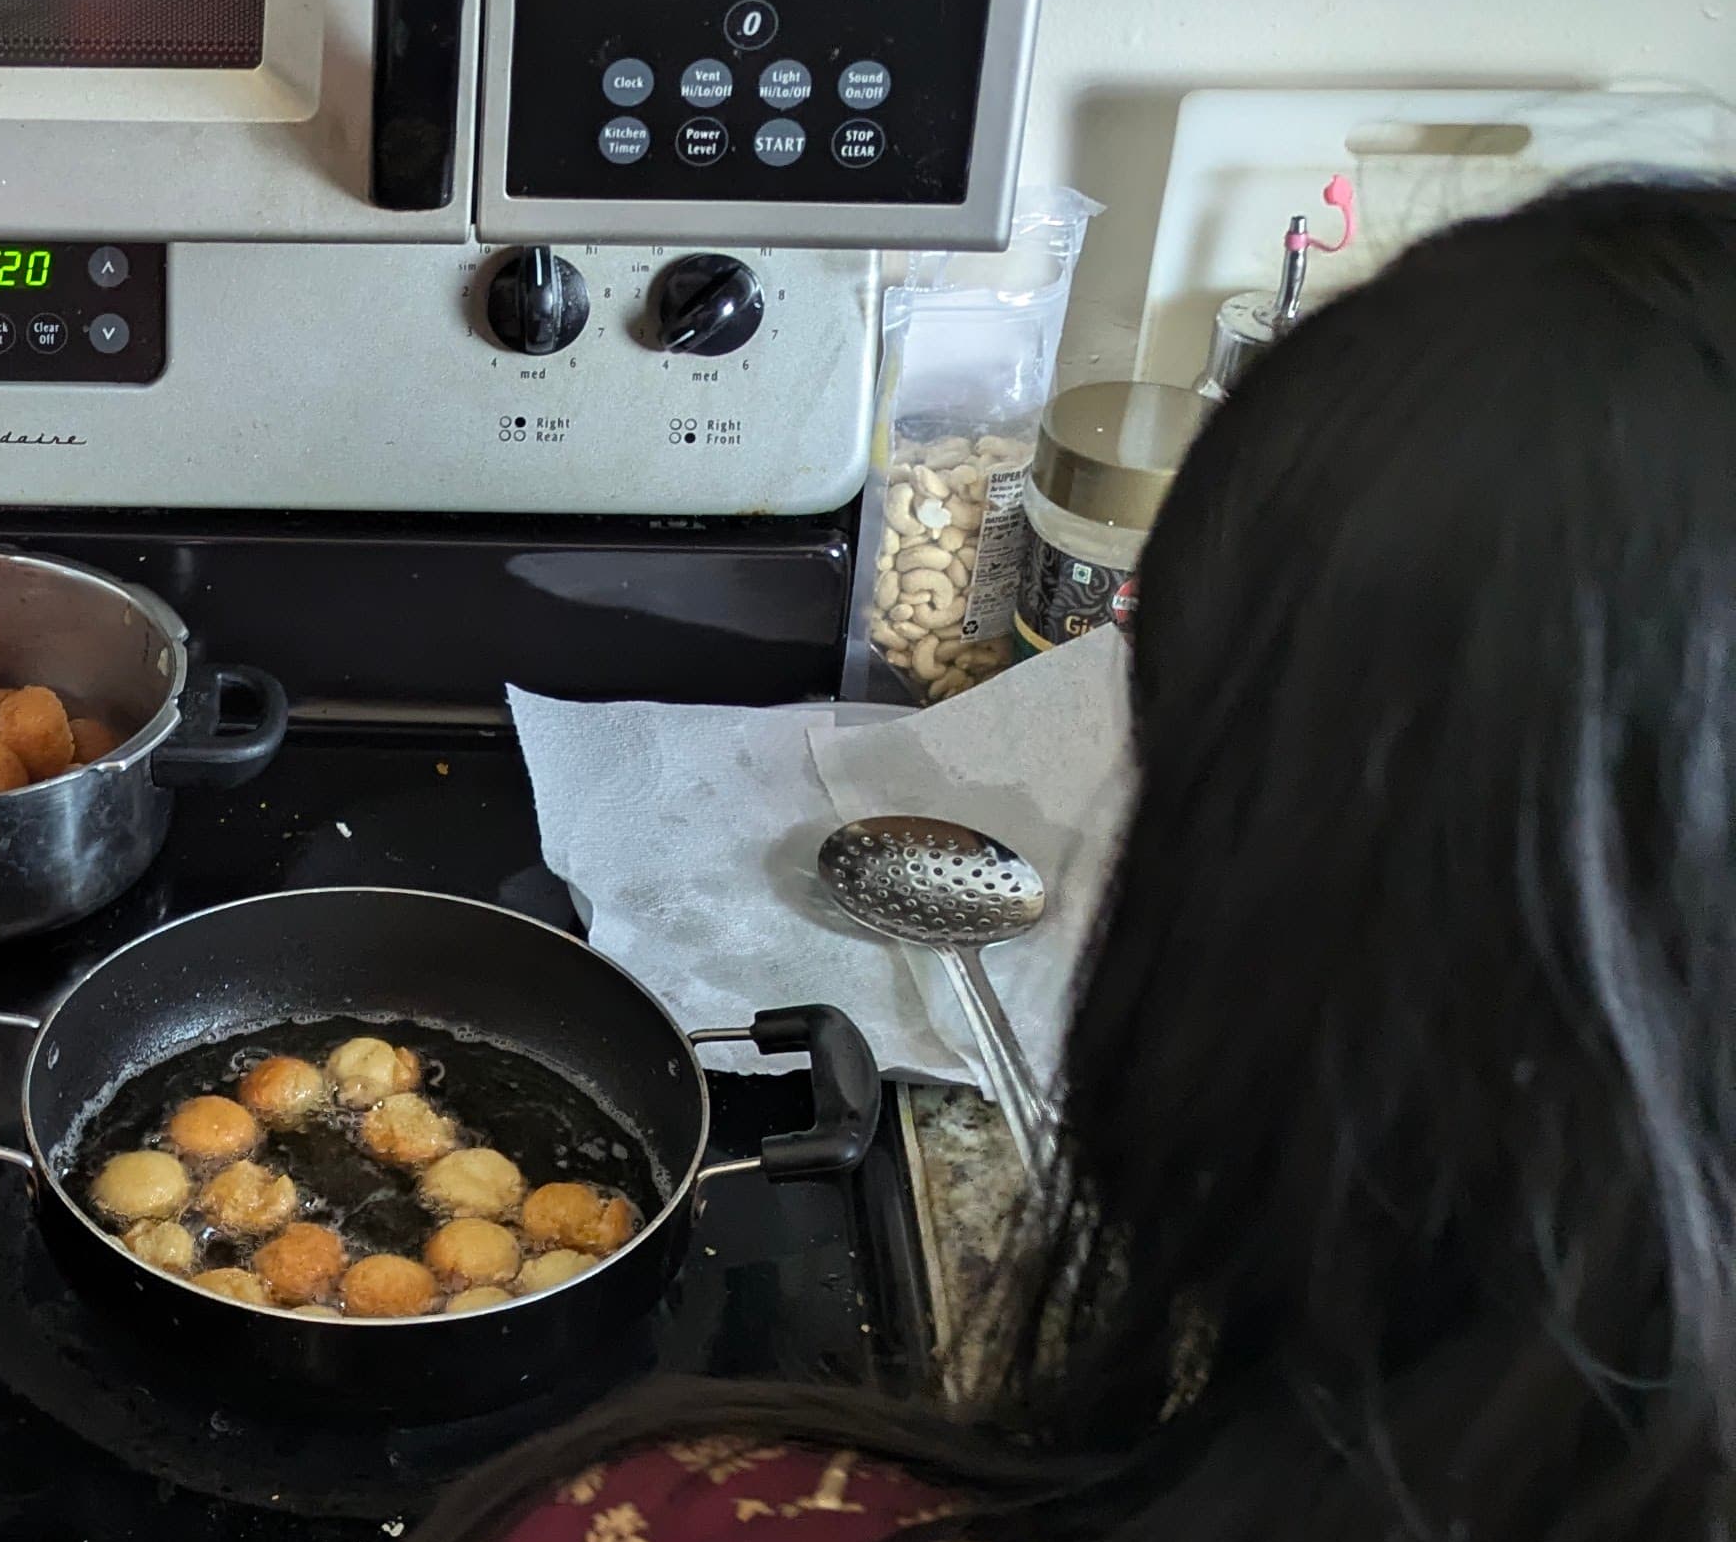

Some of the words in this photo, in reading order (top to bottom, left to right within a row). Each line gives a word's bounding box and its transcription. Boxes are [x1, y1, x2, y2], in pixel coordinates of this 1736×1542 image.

[743, 11, 762, 36] 0
[695, 71, 720, 81] Vent
[772, 70, 800, 84] Light
[848, 71, 883, 84] Sound
[614, 77, 644, 88] Clock
[681, 85, 733, 98] Hi/Lo/Off
[759, 85, 811, 98] Hi/Lo/Off
[845, 87, 883, 99] On/Off
[604, 127, 646, 139] Kitchen
[686, 128, 720, 139] Power
[845, 130, 874, 142] STOP
[608, 142, 641, 154] Timer
[687, 143, 717, 155] Level
[755, 137, 805, 152] START
[841, 145, 875, 157] CLEAR
[458, 262, 477, 271] sim
[631, 262, 650, 273] sim
[463, 287, 469, 297] 2
[604, 287, 612, 299] 8
[634, 288, 641, 299] 2
[778, 289, 785, 300] 8
[33, 322, 59, 333] Clear
[467, 326, 473, 337] 3
[598, 327, 605, 338] 7
[639, 328, 645, 339] 3
[771, 329, 778, 340] 7
[39, 334, 55, 345] Off
[491, 358, 497, 369] 4
[569, 358, 577, 368] 6
[662, 359, 669, 370] 4
[742, 360, 749, 370] 6
[520, 367, 546, 379] med
[692, 370, 719, 382] med
[536, 417, 570, 431] Right
[707, 419, 741, 431] Right
[536, 431, 565, 442] Rear
[706, 434, 741, 445] Front
